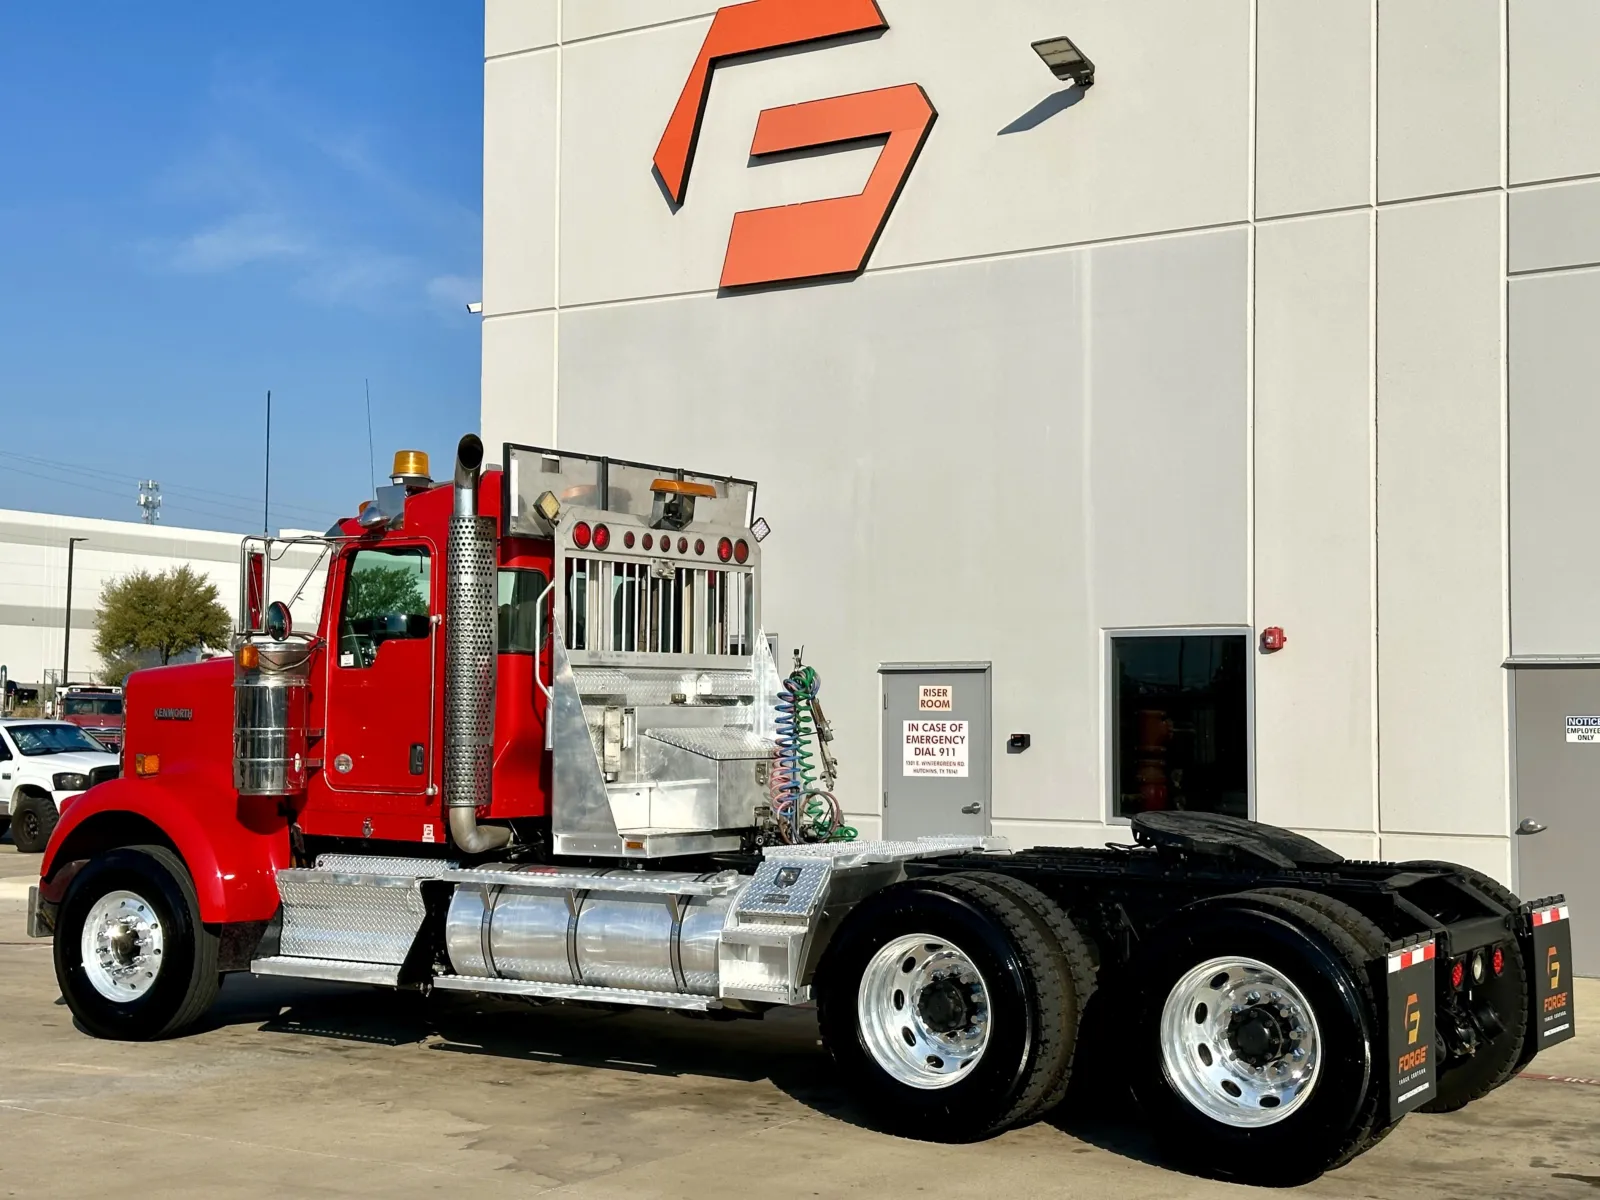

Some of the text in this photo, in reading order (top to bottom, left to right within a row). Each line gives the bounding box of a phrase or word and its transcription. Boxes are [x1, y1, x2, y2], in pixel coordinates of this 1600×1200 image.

[923, 688, 948, 698] RISER
[920, 699, 951, 709] ROOM
[154, 707, 193, 718] KENWORTH
[908, 723, 964, 732] IN CASE OF
[905, 734, 966, 745] EMERGENCY
[914, 747, 956, 757] DIAL 911
[1544, 992, 1567, 1013] FORGE
[1398, 1045, 1427, 1074] FORGE
